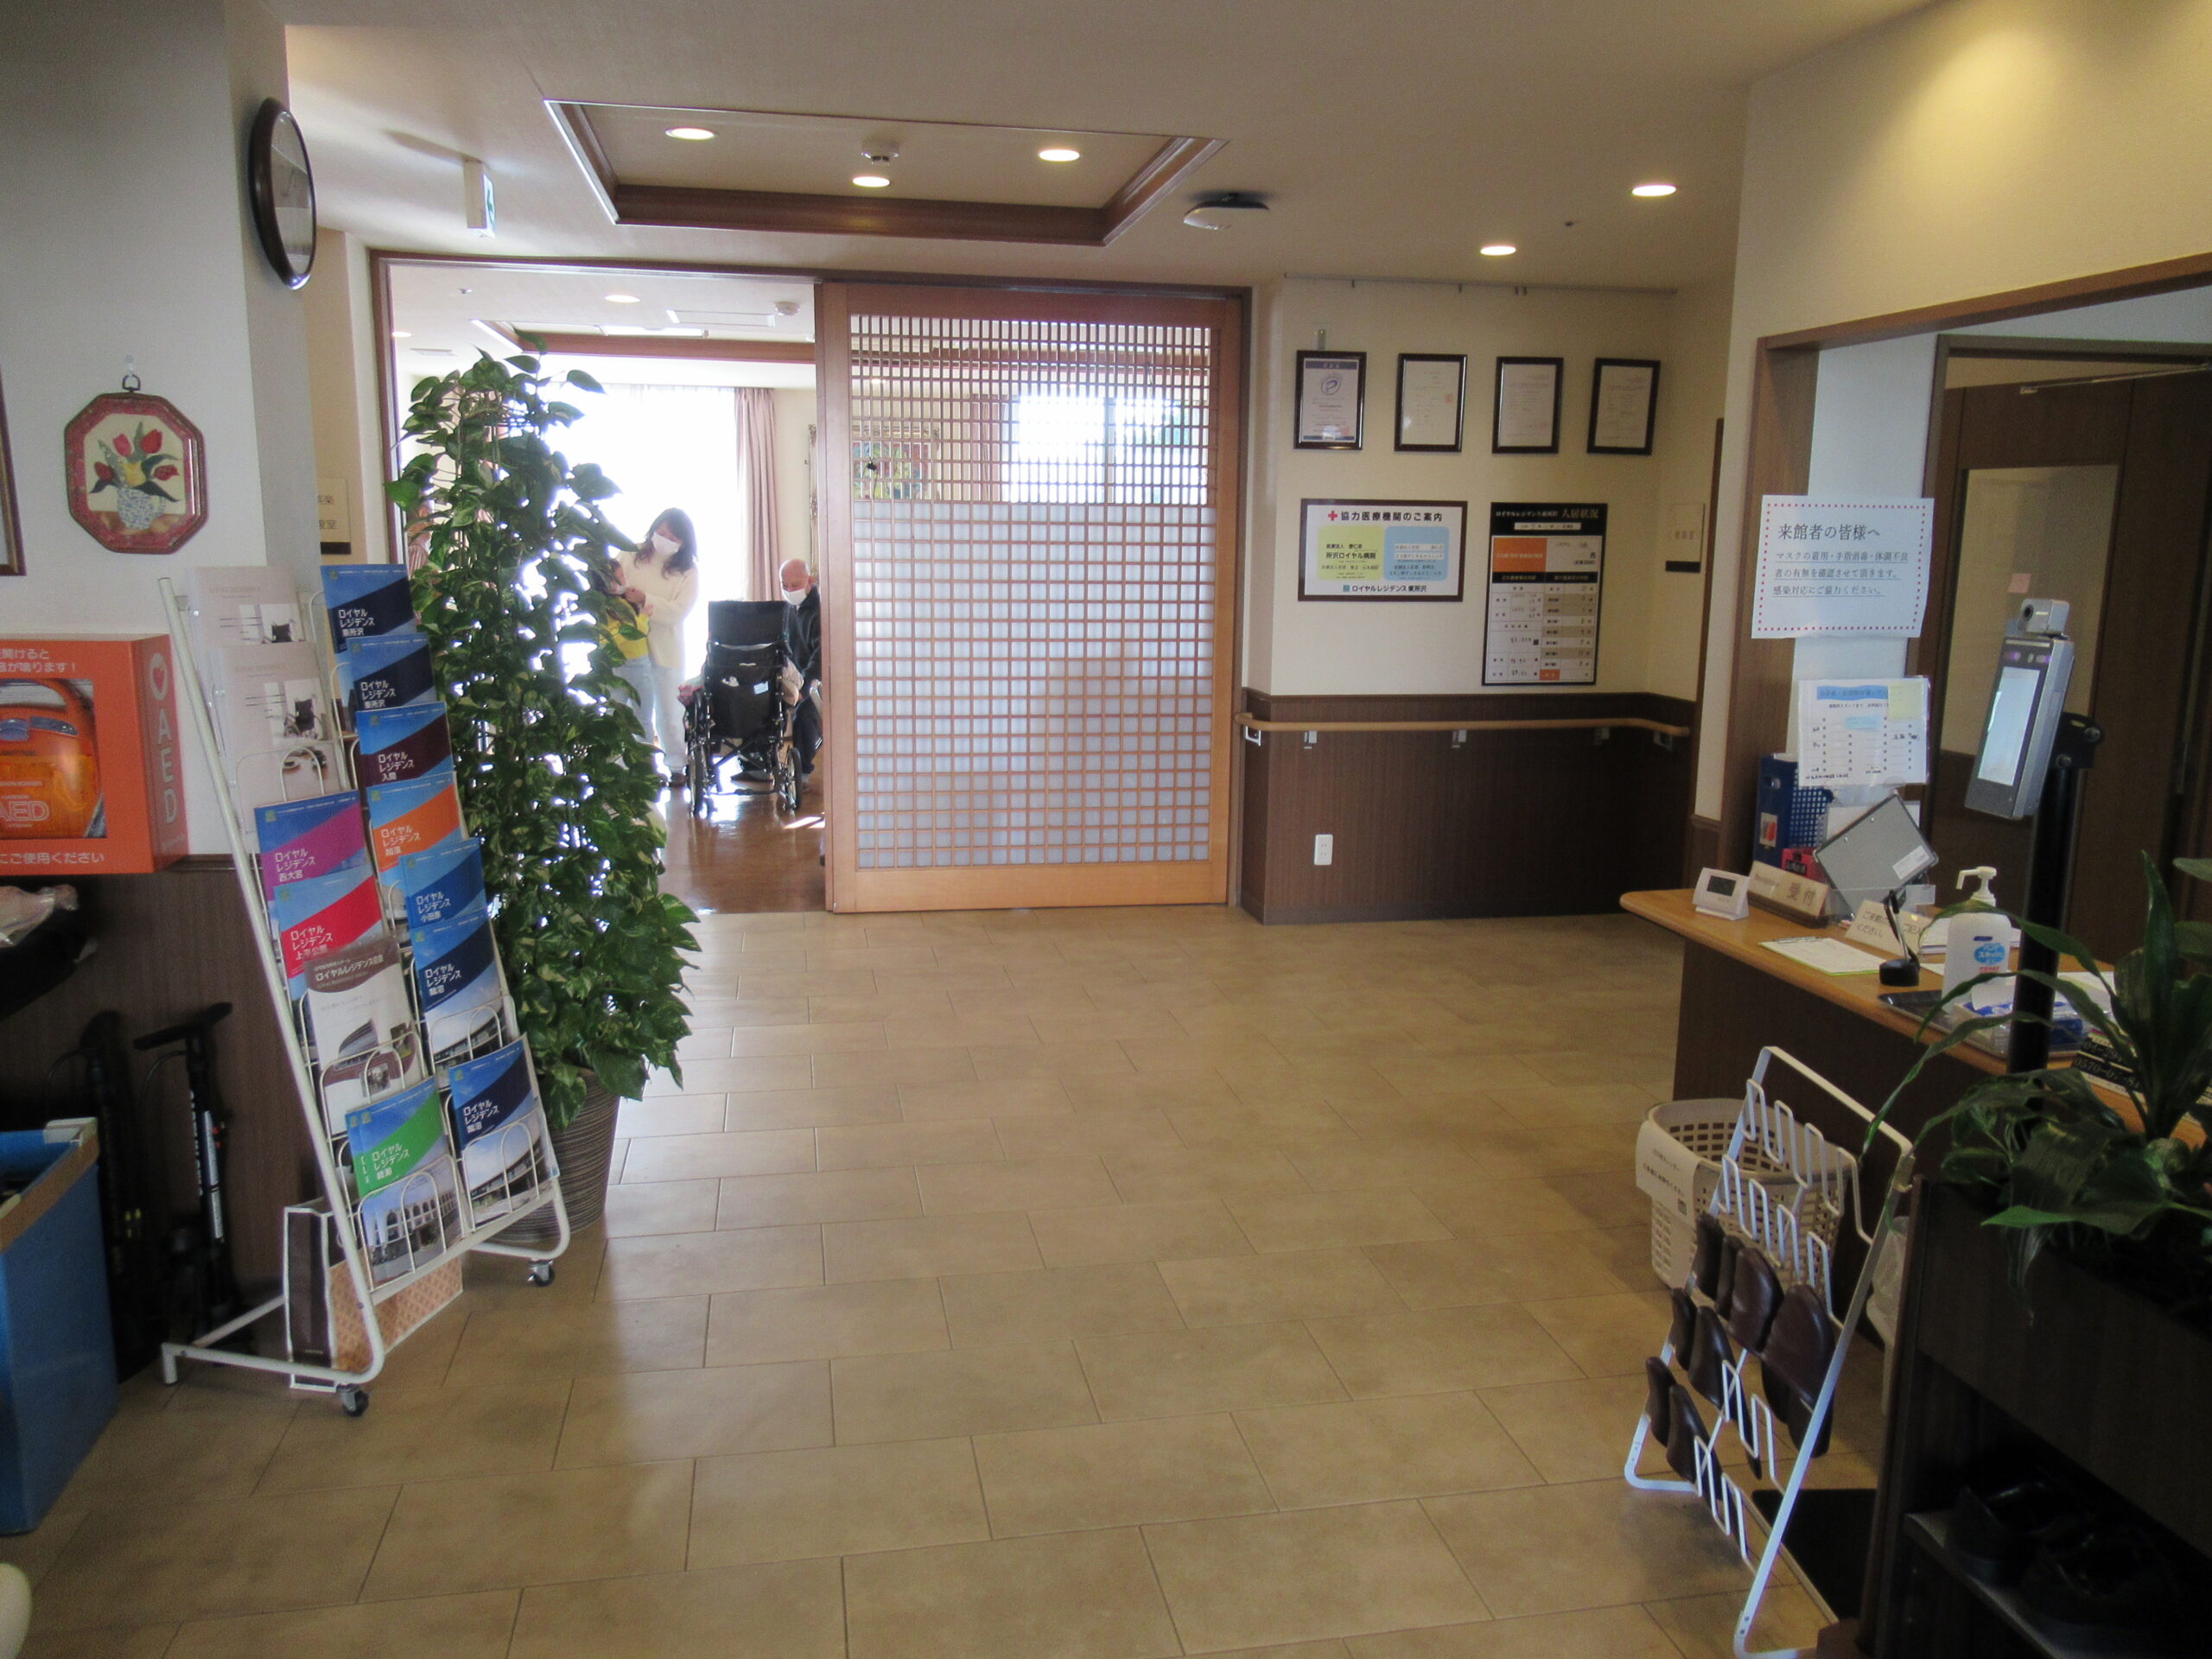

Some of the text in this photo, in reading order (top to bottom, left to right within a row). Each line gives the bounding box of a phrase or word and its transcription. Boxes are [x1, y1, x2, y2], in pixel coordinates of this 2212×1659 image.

[1340, 512, 1442, 522] 協力医療機関のご案内
[1778, 523, 1880, 540] 来館者の皆様へ
[1776, 551, 1908, 561] マスクの着用・手指消毒・体調不良
[1775, 568, 1897, 578] 者の有無を確認させて頂きます。
[1773, 585, 1881, 595] 感染対応にご協力ください。
[338, 608, 368, 619] ロイヤル
[340, 617, 375, 628] レジデンス
[0, 650, 49, 660] 開けると
[360, 680, 390, 691] ロイヤル
[362, 689, 397, 701] レジデンス
[378, 751, 409, 763] ロイヤル
[157, 708, 178, 823] AED
[378, 760, 415, 772] レジデンス
[381, 824, 413, 838] ロイヤル
[383, 832, 421, 848] レジデンス
[275, 848, 308, 862] ロイヤル
[276, 856, 316, 873] レジデンス
[279, 869, 304, 883] 西大宮
[416, 891, 444, 906] ロイヤル
[1786, 881, 1816, 906] 受付
[417, 898, 451, 914] レジデンス
[290, 924, 325, 941] ロイヤル
[292, 932, 334, 950] レジデンス
[424, 963, 455, 979] ロイヤル
[426, 969, 462, 988] レジデンス
[462, 1099, 492, 1116] ロイヤル
[464, 1105, 500, 1126] レジデンス
[371, 1142, 403, 1162] ロイヤル
[373, 1149, 410, 1171] レジデンス
